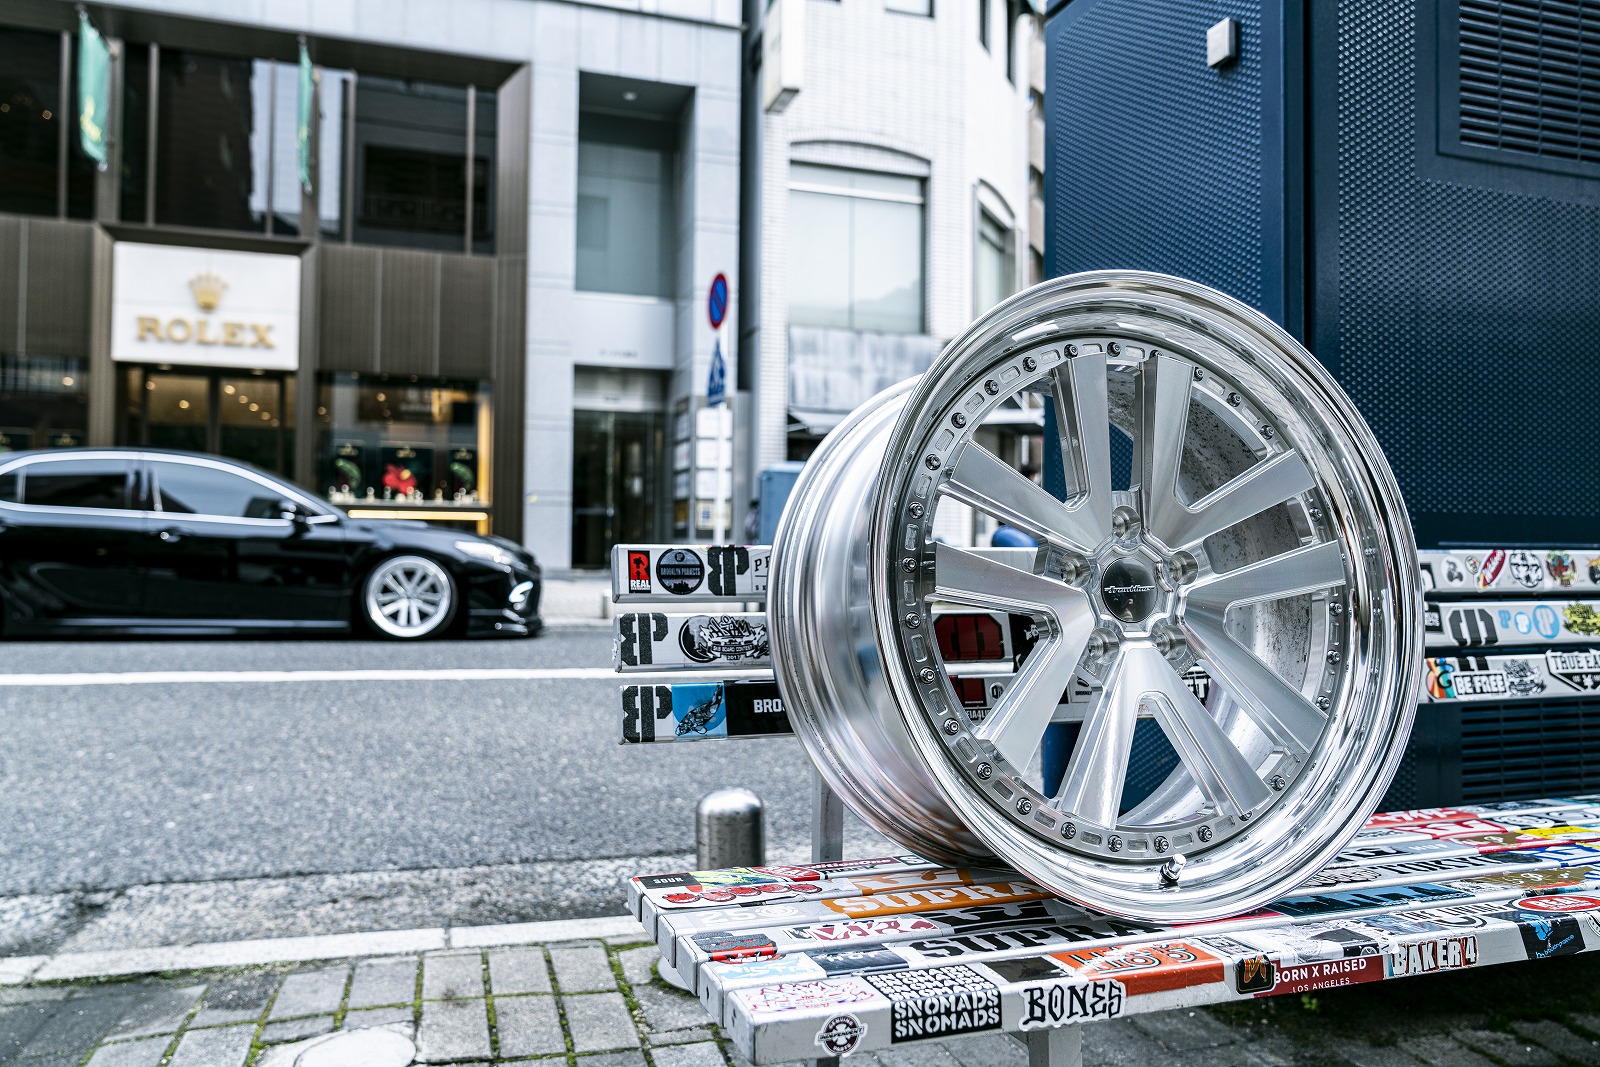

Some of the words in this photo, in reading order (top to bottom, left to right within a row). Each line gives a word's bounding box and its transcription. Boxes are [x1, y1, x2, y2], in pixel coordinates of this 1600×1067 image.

[137, 316, 275, 349] ROLEX
[630, 580, 651, 588] REAL
[1551, 655, 1584, 670] TRUE
[1455, 676, 1473, 696] BE
[1473, 673, 1506, 693] FREE
[753, 698, 786, 713] BRO
[833, 881, 1044, 912] SUPRA
[909, 920, 1165, 958] SUPRA
[1275, 968, 1309, 984] BORN
[1311, 966, 1320, 978] X
[1323, 958, 1367, 976] RAISED
[1393, 938, 1461, 975] BAKER
[1292, 984, 1309, 993] LOS
[1312, 977, 1350, 990] ANGELES
[894, 989, 999, 1019] SNOMADS
[1024, 983, 1123, 1026] BONES
[894, 1007, 999, 1038] SNOMADS
